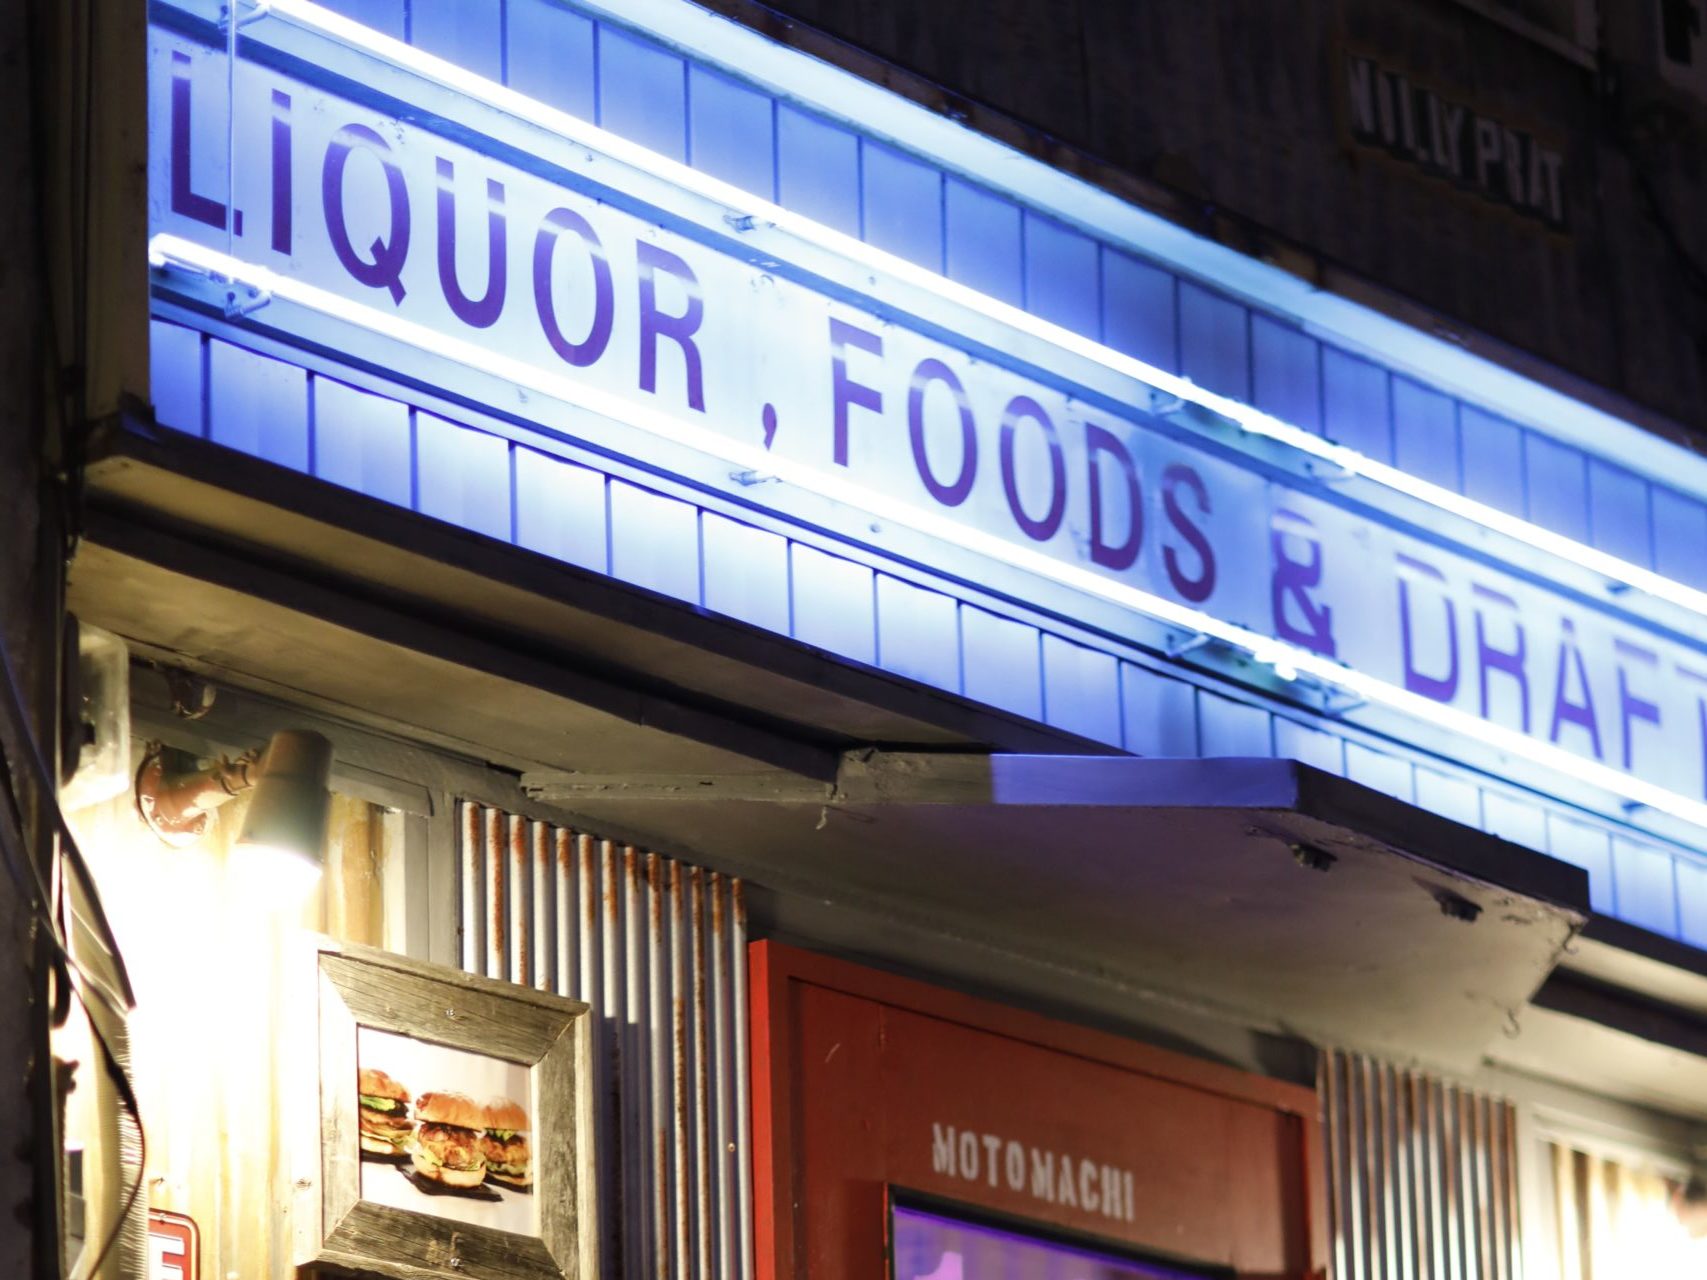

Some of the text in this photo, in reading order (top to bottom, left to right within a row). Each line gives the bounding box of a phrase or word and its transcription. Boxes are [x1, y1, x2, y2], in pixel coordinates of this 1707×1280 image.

[828, 316, 1218, 602] FOODS
[1269, 506, 1337, 660] &
[932, 1121, 1136, 1222] MOTOMACHI
